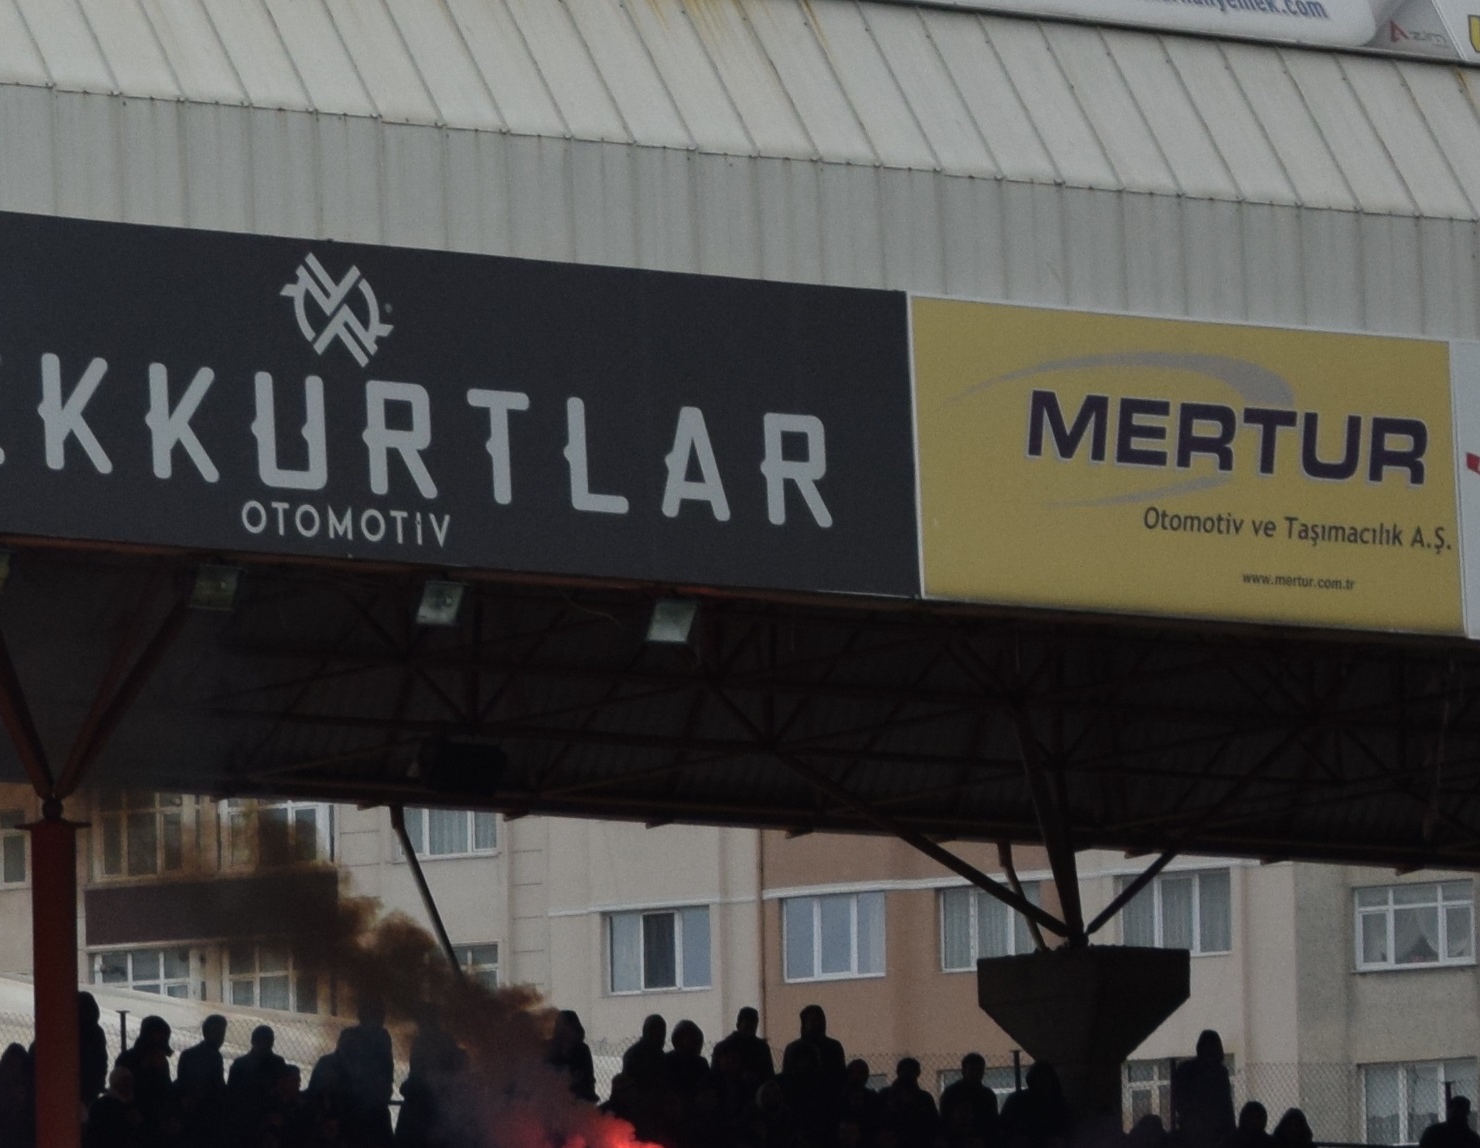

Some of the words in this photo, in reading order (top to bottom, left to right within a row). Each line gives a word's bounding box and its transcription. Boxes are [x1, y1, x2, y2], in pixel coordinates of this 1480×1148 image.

[1026, 389, 1429, 486] MERTUR
[1143, 506, 1245, 537] Otomotiv
[1251, 519, 1277, 538] ve
[1284, 515, 1404, 549] Taşımacılık
